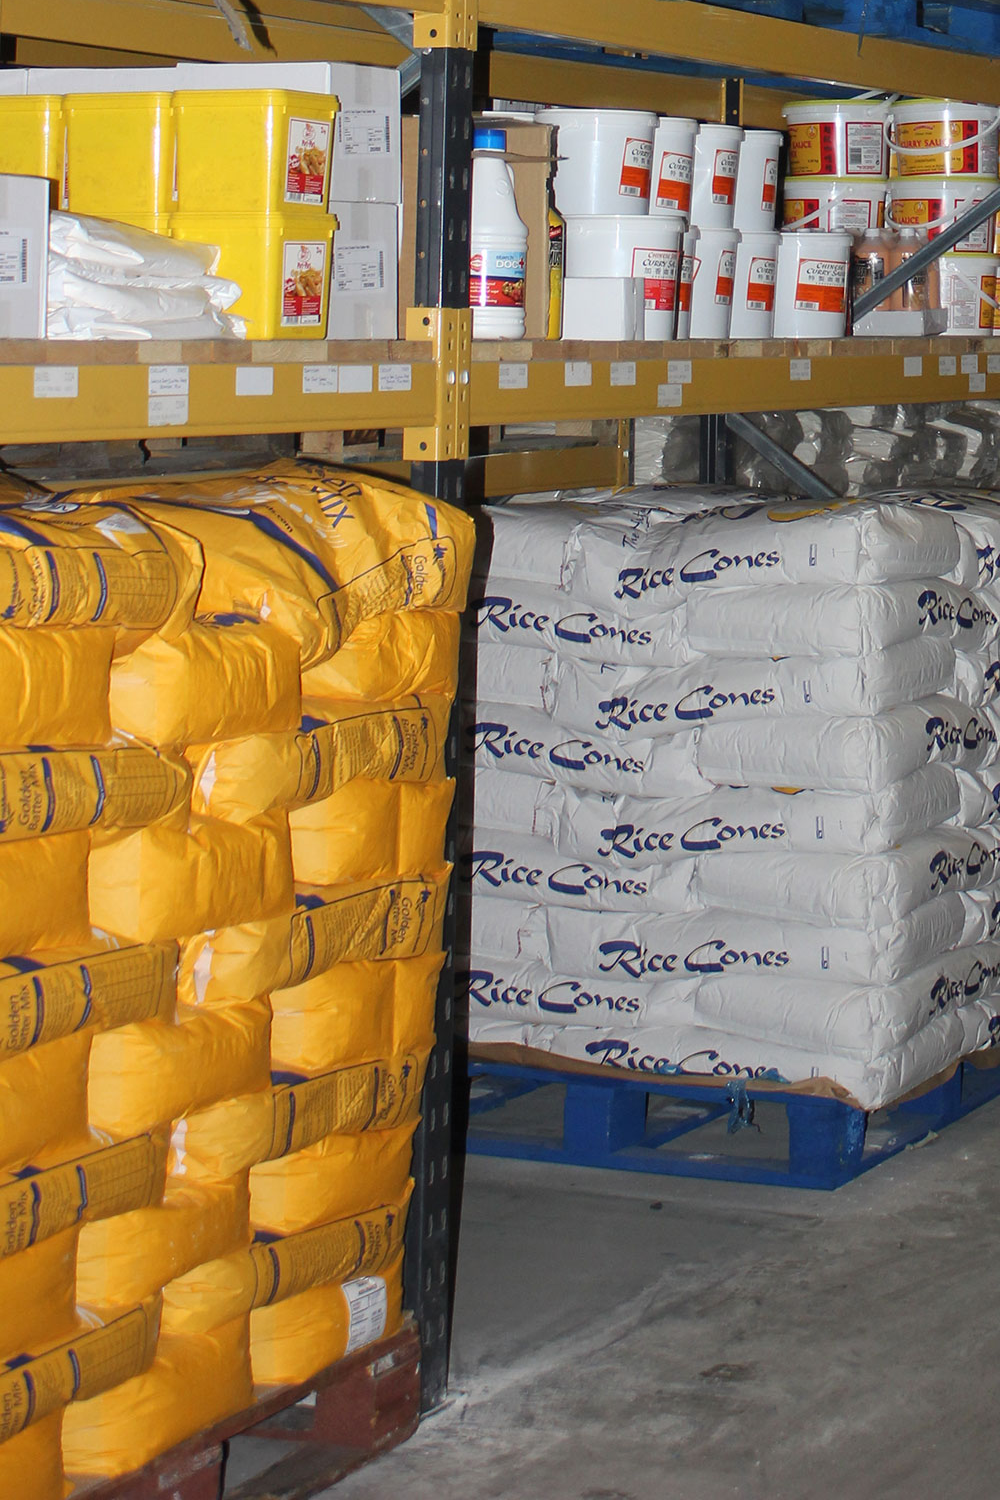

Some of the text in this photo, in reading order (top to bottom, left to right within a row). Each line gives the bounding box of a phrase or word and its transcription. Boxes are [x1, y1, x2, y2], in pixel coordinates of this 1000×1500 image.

[614, 548, 781, 599] Rice Cones
[470, 597, 652, 643] Rice Cones
[917, 590, 955, 625] Rice
[595, 685, 776, 731] Rice Cones
[468, 722, 646, 773] Rice Cones
[18, 769, 31, 825] Golden
[597, 817, 786, 858] Rice Cones
[462, 851, 648, 895] Rice Cones
[599, 940, 790, 978] Rice Cones
[468, 970, 640, 1014] Rice Cones
[586, 1039, 768, 1078] Rice Cone
